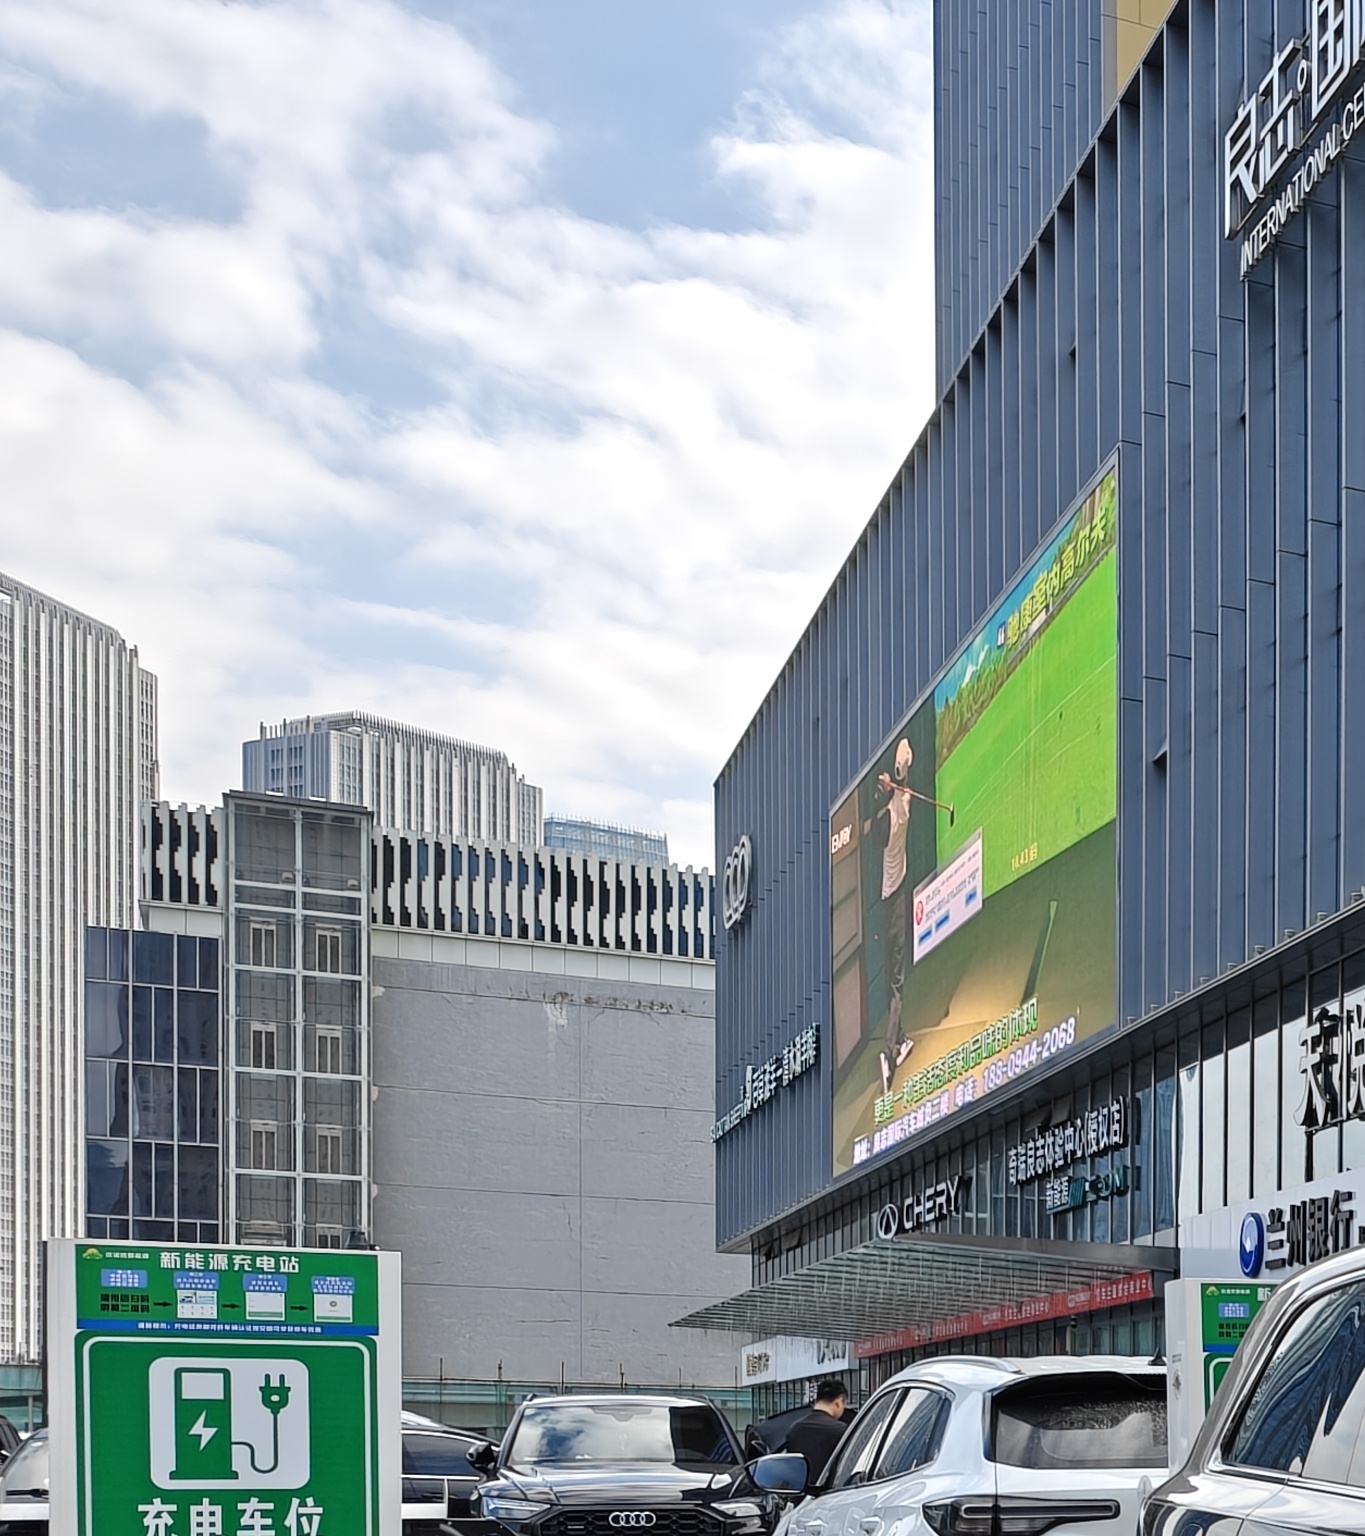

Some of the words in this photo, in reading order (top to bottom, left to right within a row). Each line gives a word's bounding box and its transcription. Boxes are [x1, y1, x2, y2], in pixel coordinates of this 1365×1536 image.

[1240, 123, 1341, 282] INTERNATIONAL
[981, 1016, 1076, 1094] 188-0944-2068
[903, 1174, 964, 1231] CHERY
[1265, 1188, 1358, 1270] 兰州银行
[159, 1251, 300, 1274] 新能源充电站
